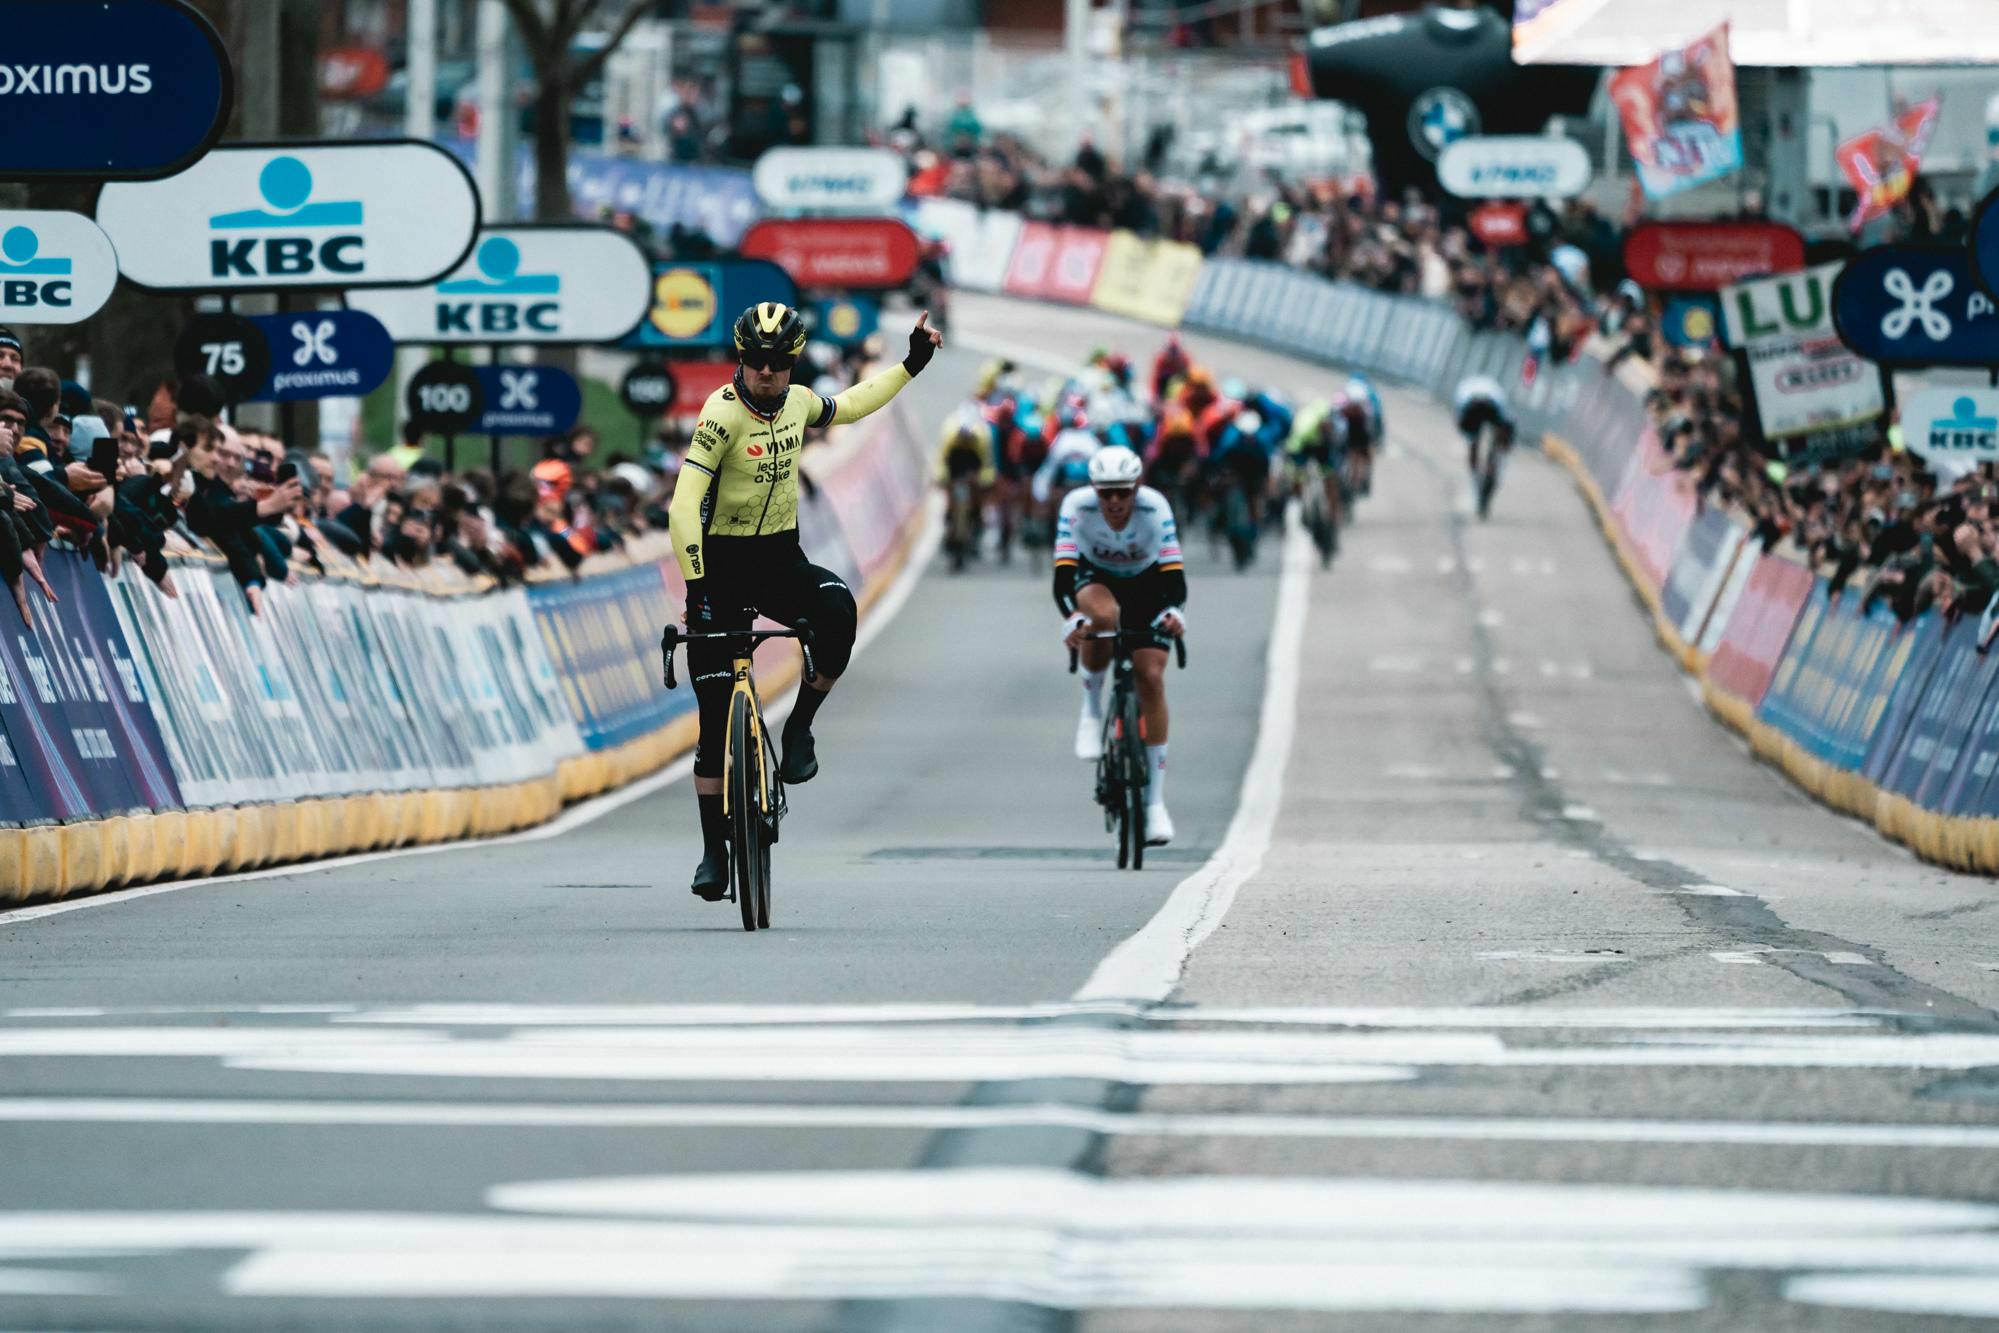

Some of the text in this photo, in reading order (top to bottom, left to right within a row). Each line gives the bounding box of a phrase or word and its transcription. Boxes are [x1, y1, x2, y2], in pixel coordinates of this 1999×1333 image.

[211, 235, 364, 277] KBC
[0, 280, 72, 308] BC
[437, 302, 560, 333] KBC
[201, 342, 245, 376] 75
[273, 369, 359, 392] proximus
[418, 384, 471, 413] 100
[706, 419, 730, 444] VISMA
[1929, 432, 1997, 450] KBC
[766, 434, 801, 455] VISMA
[757, 458, 792, 472] lease
[690, 554, 702, 575] AGU
[696, 671, 732, 682] cervélo
